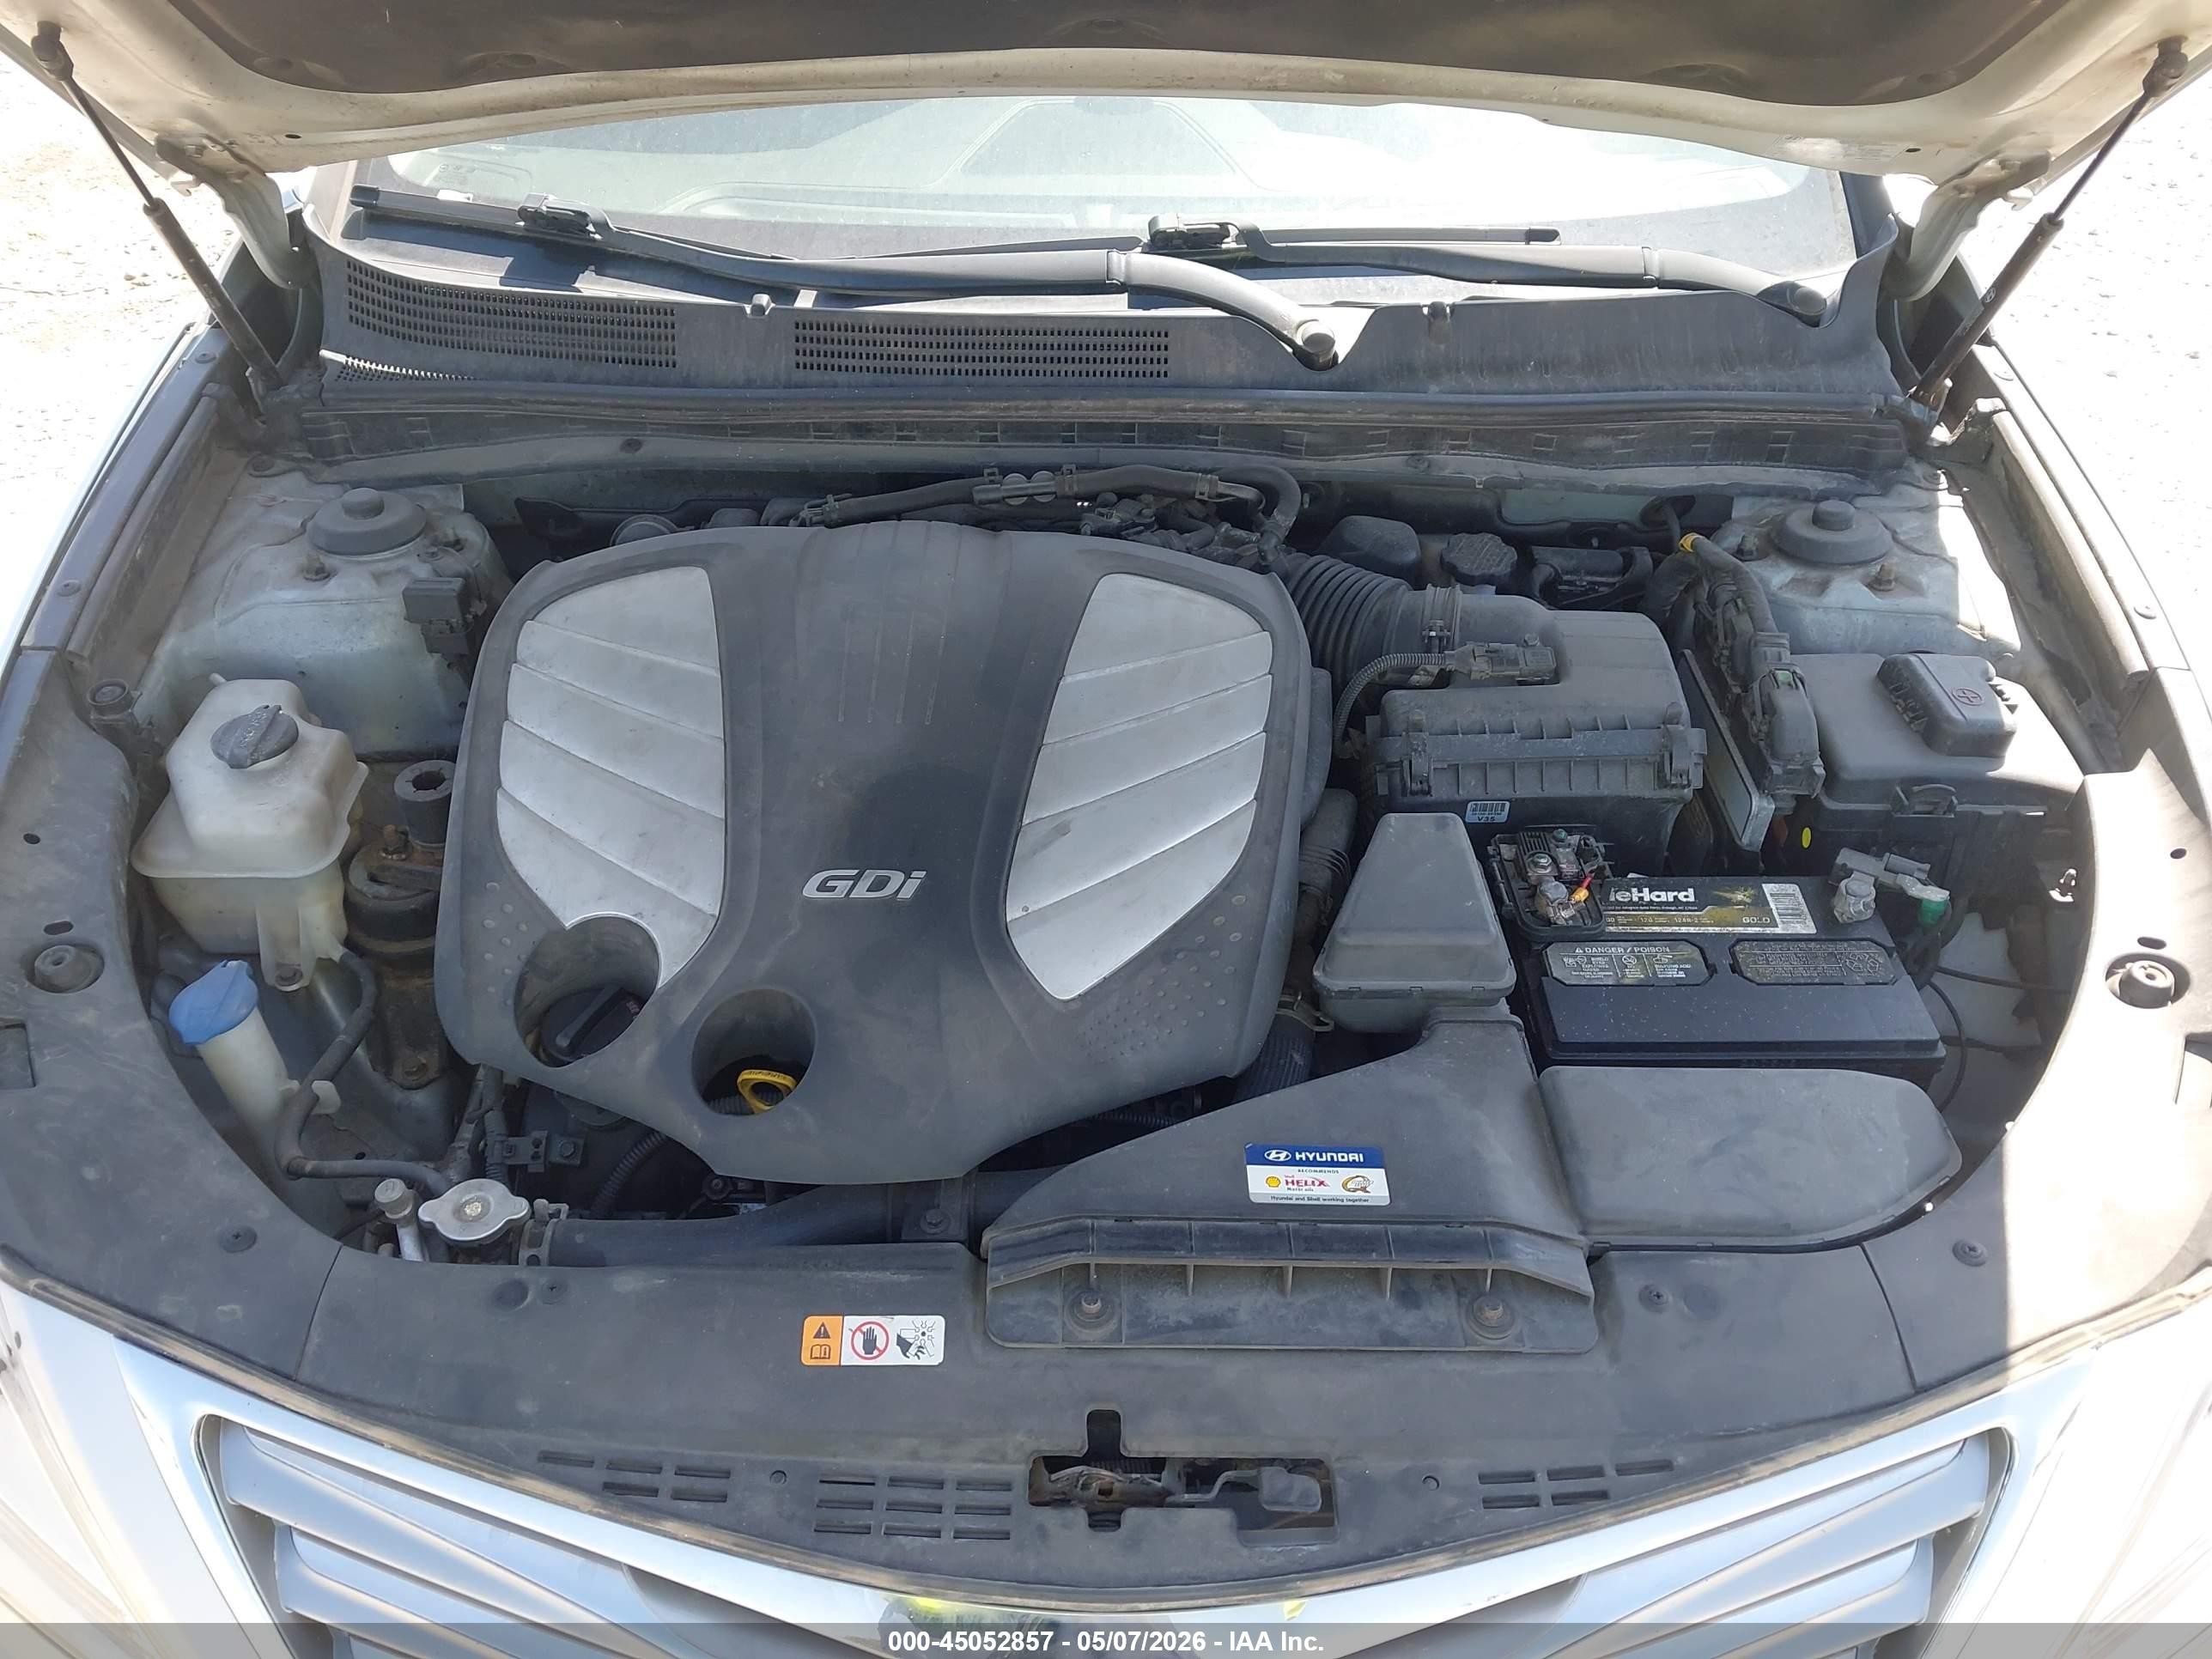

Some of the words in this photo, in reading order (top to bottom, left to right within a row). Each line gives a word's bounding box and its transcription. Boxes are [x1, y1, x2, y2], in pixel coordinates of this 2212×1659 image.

[802, 869, 927, 899] GDi
[1607, 886, 1696, 902] ieHard
[1295, 1152, 1364, 1163] HYUNDAI
[1285, 1178, 1328, 1188] HELIX
